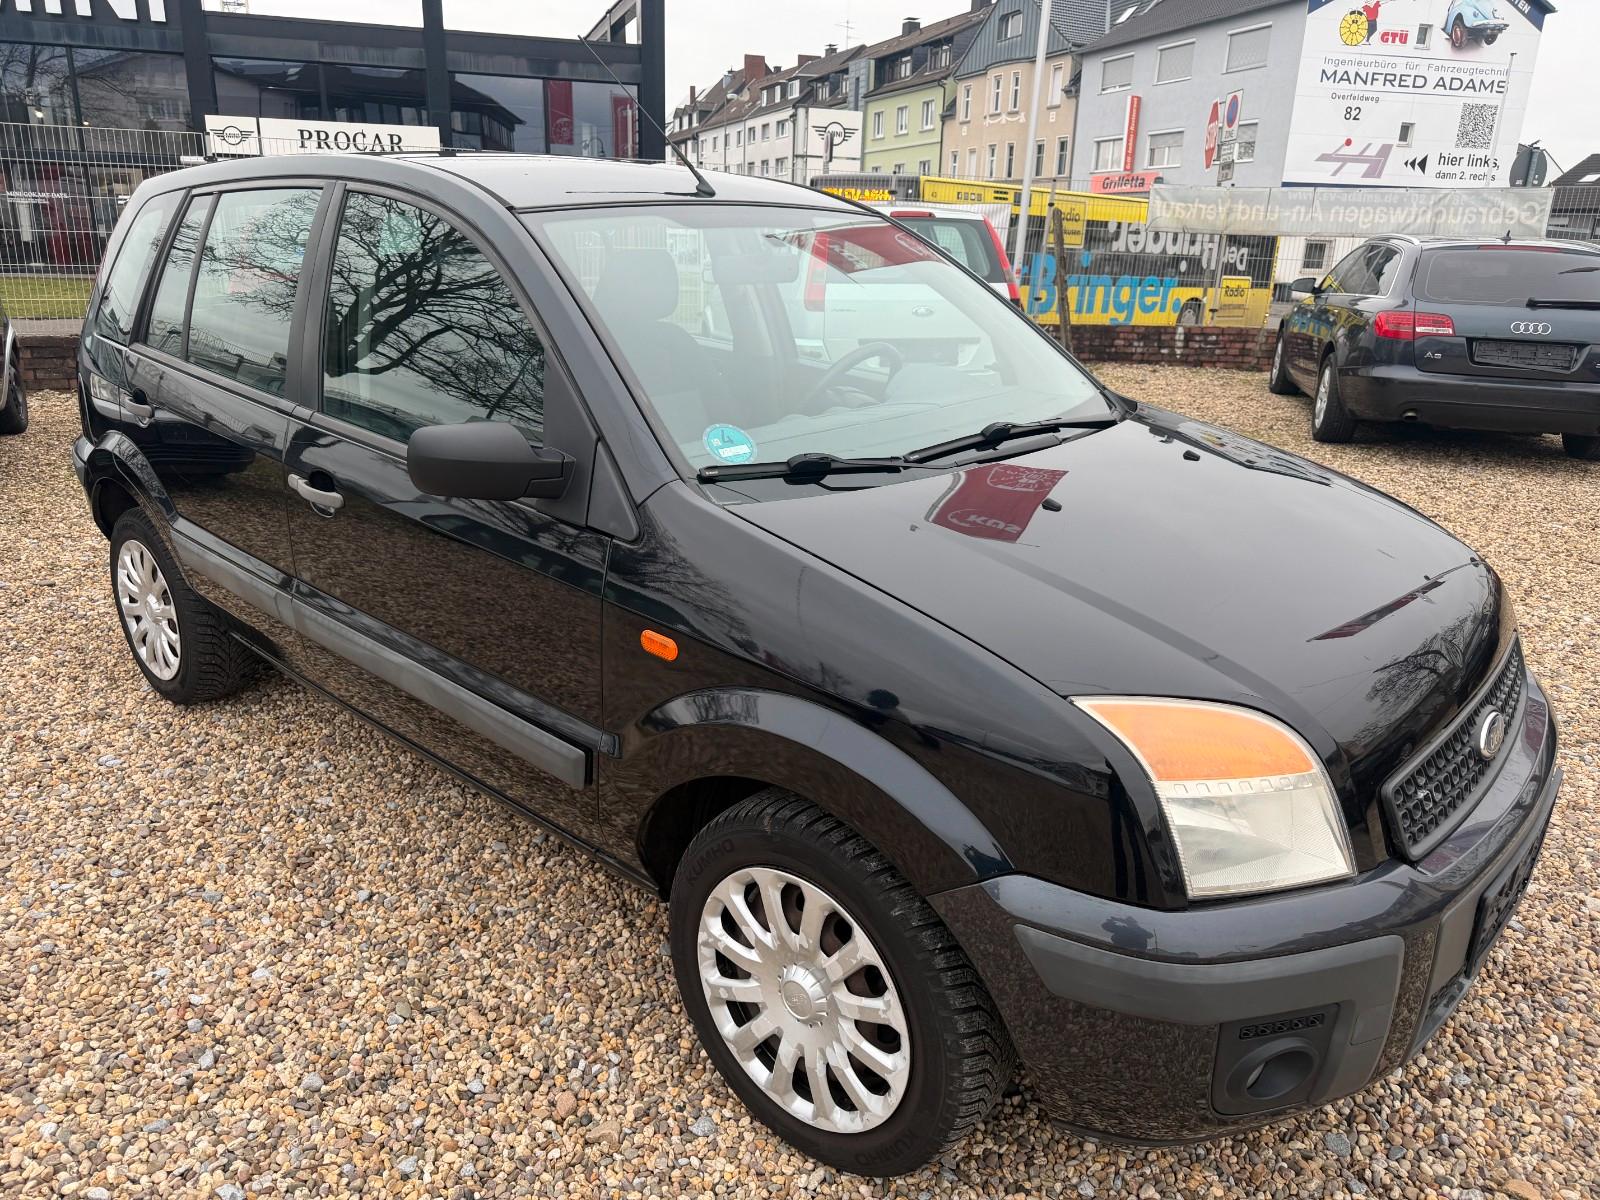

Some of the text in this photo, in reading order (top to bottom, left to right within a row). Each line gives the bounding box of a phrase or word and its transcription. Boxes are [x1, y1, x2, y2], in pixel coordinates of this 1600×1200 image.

[1380, 30, 1408, 45] GTÜ
[1324, 56, 1397, 70] Ingenieurbüro
[1405, 61, 1419, 71] für
[1320, 69, 1508, 94] MANFRED ADAMS
[1331, 92, 1380, 103] Overfeldweg
[1344, 107, 1361, 121] 82
[297, 129, 404, 151] PROCAR
[1438, 152, 1500, 170] hier links,
[1102, 176, 1145, 190] Grilletta
[1435, 170, 1496, 181] dann 2. rechs
[721, 429, 735, 444] 4
